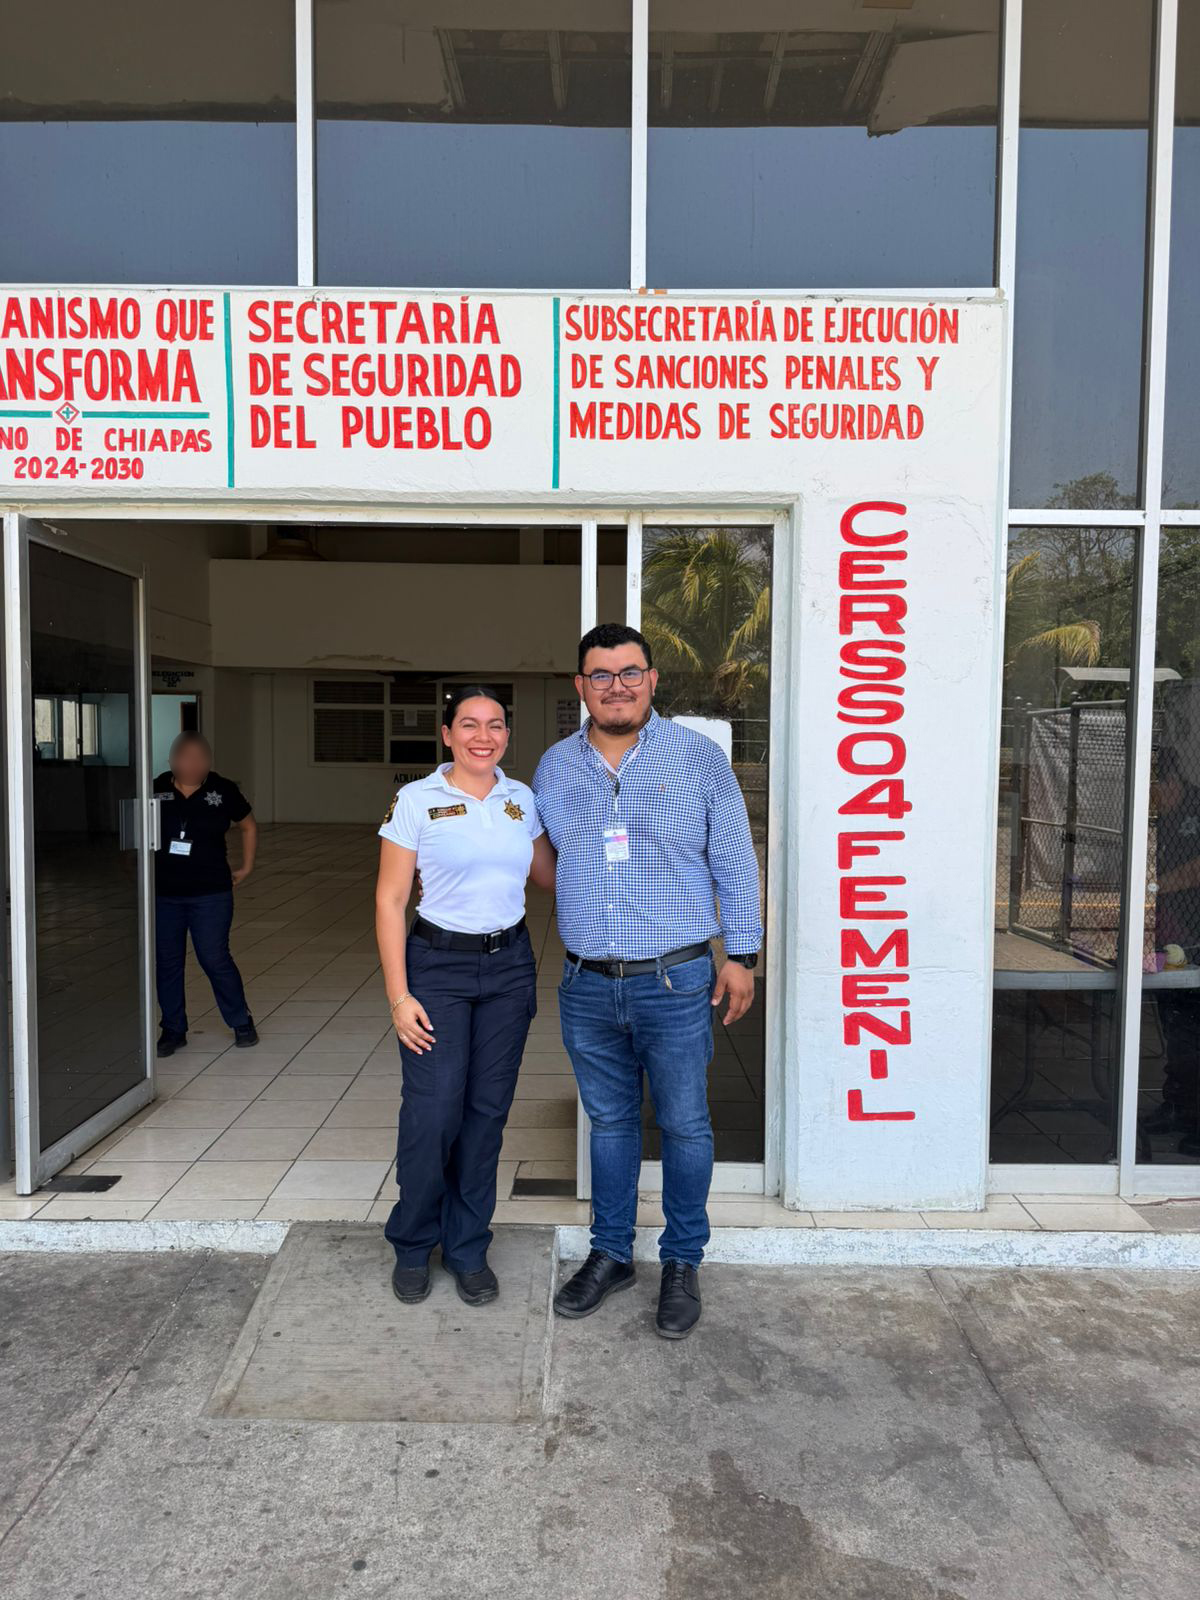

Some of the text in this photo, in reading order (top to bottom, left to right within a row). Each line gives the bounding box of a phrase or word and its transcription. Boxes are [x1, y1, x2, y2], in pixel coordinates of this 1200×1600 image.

[155, 299, 215, 345] QUE
[247, 295, 500, 345] SECRETARÍA
[564, 299, 960, 345] SUBSECRETARÍA DE EJECUCIÓN
[0, 347, 202, 403] NSFORMA
[248, 352, 522, 398] DE SEGURIDAD
[570, 353, 940, 392] DE SANCIONES PENALES Y
[55, 427, 83, 452] DE
[103, 427, 212, 453] CHIAPAS
[249, 404, 492, 451] DEL PUEBLO
[568, 400, 925, 441] MEDIDAS DE SEGURIDAD
[13, 455, 144, 481] 2024-2030
